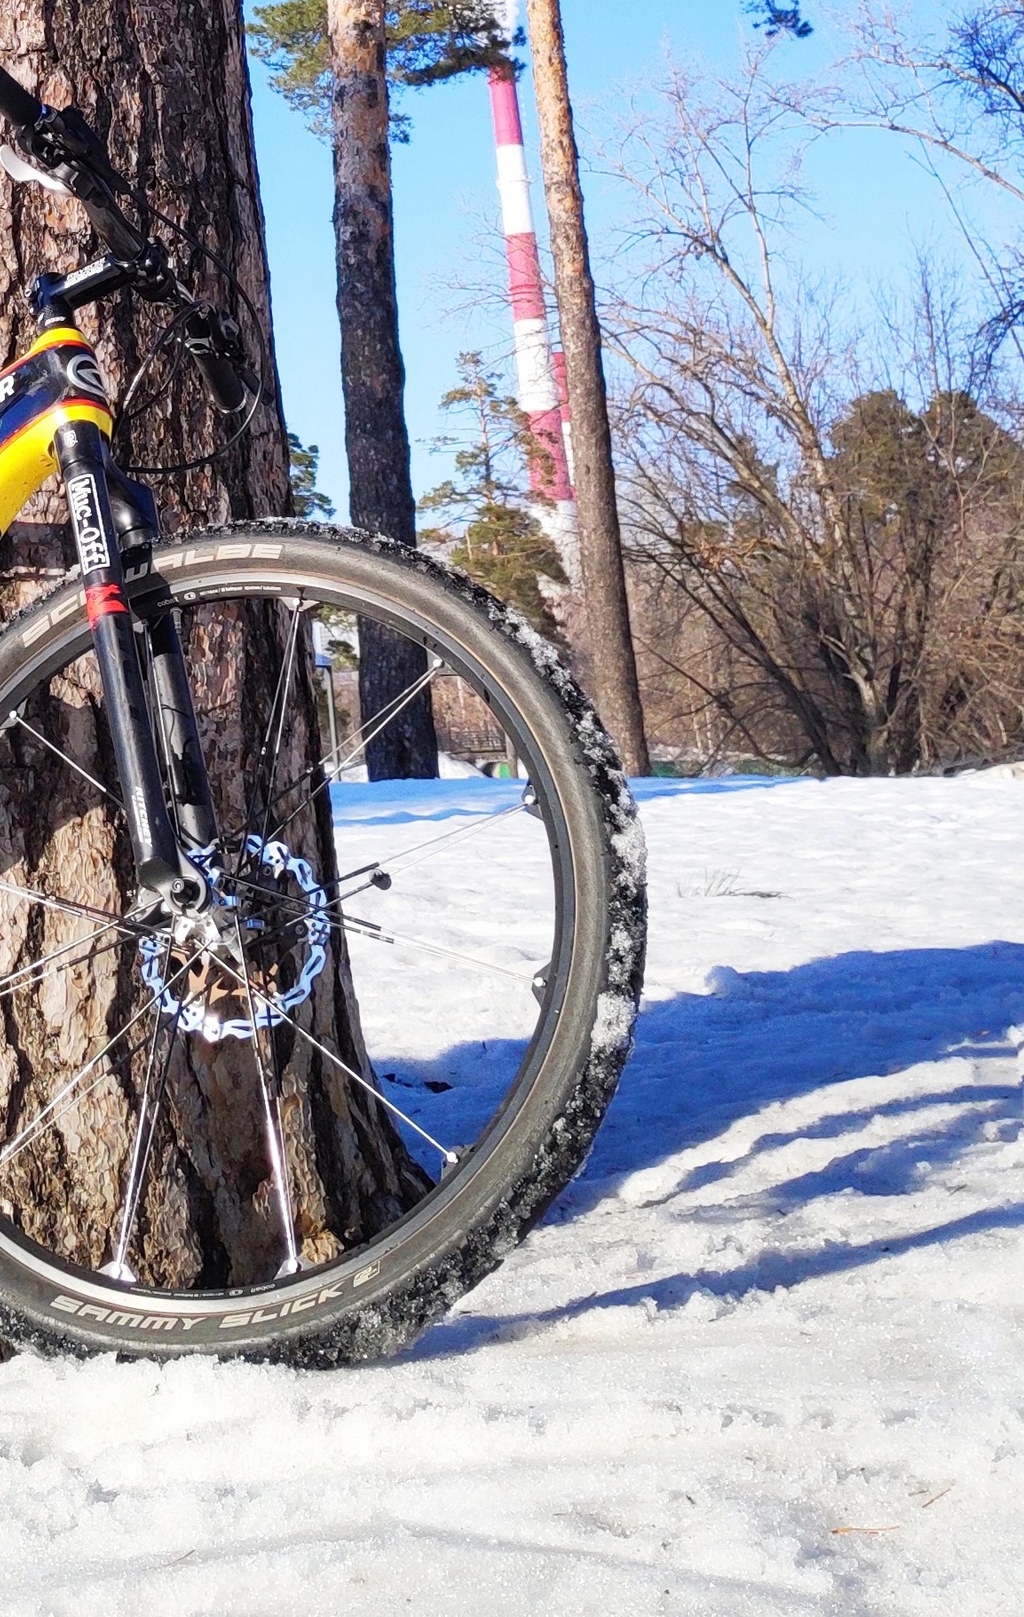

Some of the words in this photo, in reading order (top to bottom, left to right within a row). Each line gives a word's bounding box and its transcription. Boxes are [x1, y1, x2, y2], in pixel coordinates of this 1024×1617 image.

[72, 478, 107, 569] Muc-Off
[49, 1294, 207, 1331] SAMMY
[219, 1280, 346, 1329] SLICK
